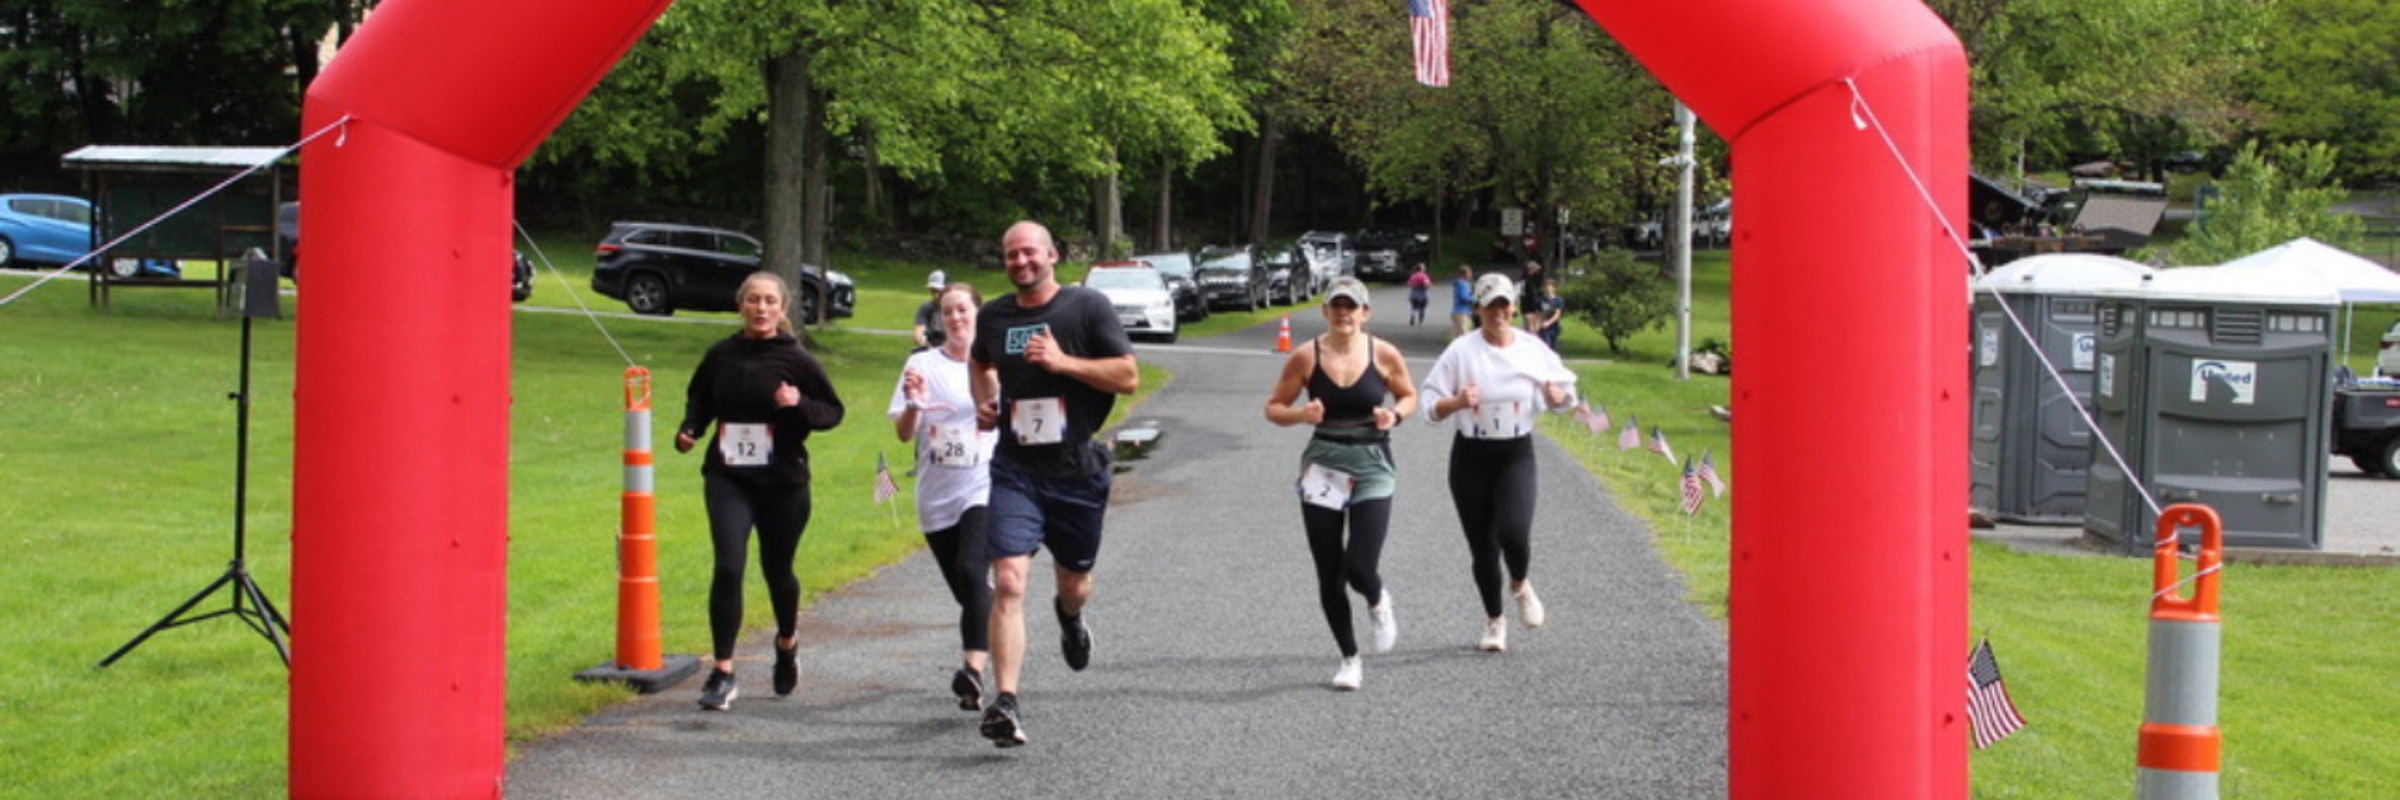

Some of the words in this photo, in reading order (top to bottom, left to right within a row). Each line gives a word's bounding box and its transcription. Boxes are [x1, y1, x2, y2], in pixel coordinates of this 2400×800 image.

[1032, 418, 1043, 434] 7
[1492, 418, 1500, 430] 1
[738, 441, 757, 457] 12
[944, 442, 965, 457] 28
[1319, 481, 1332, 498] 2
